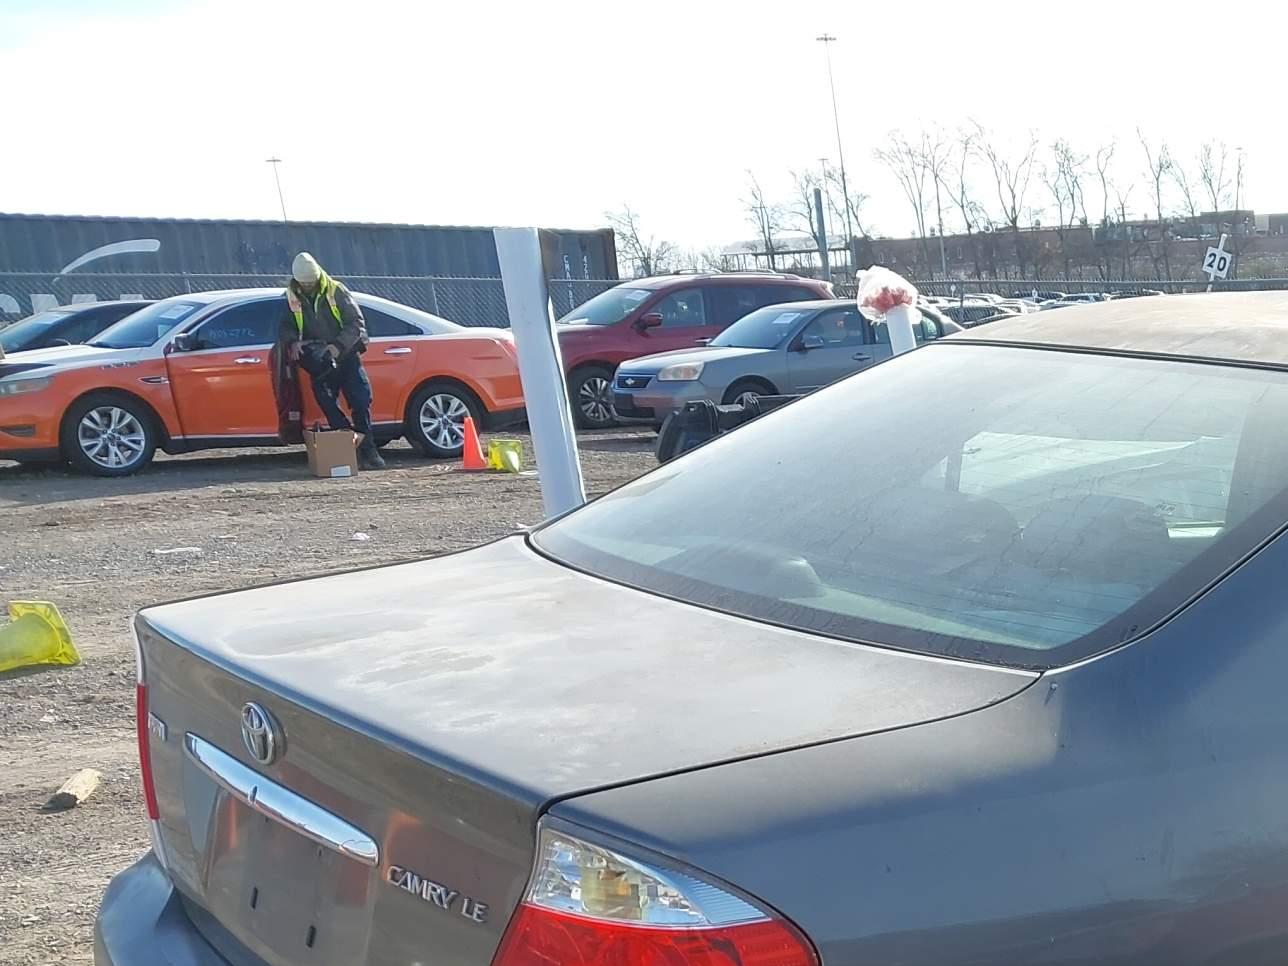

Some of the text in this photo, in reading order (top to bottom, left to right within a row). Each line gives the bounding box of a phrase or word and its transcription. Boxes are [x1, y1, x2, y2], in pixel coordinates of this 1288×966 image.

[1206, 252, 1227, 272] 20
[387, 865, 489, 923] CAMRY LE
